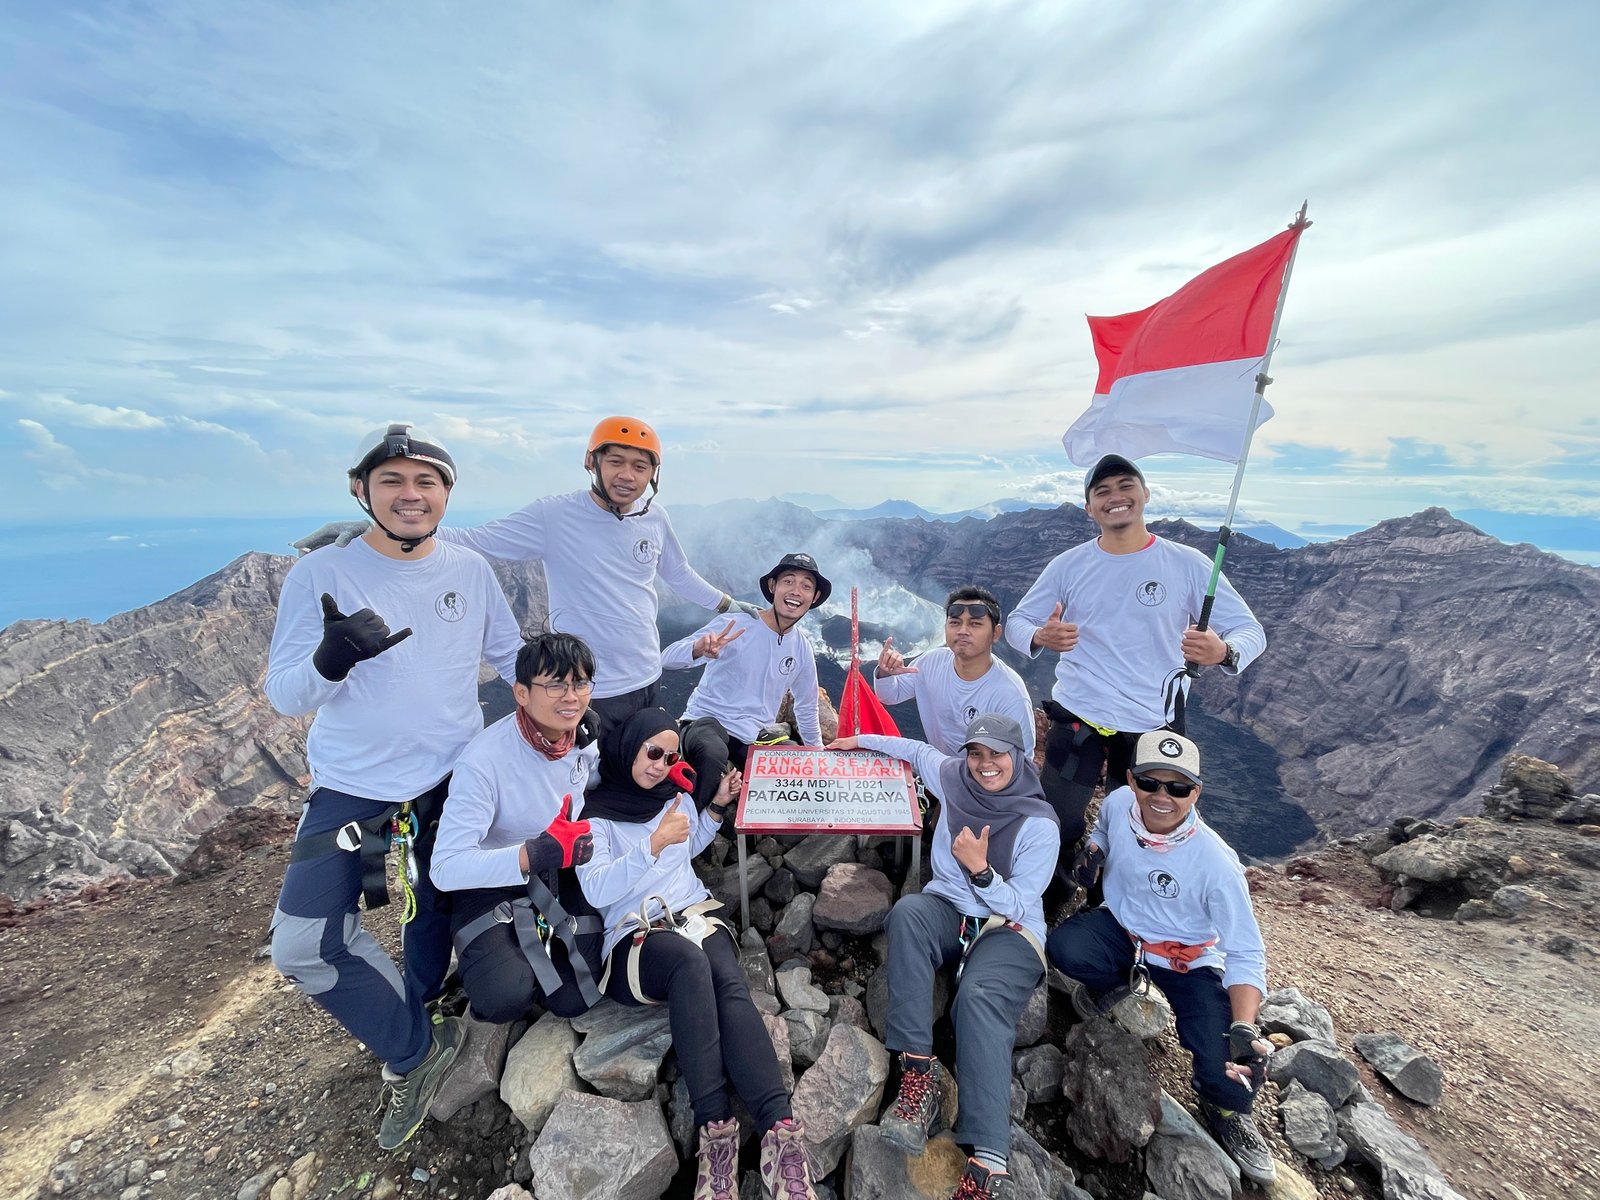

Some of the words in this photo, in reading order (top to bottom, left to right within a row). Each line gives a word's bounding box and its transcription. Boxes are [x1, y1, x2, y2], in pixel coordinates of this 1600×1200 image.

[757, 756, 827, 766] PUNCAK
[836, 757, 903, 768] SEJATI
[755, 765, 814, 776] RAUNG
[818, 766, 903, 777] KALIBARU
[774, 778, 804, 788] 3344
[807, 779, 845, 789] MDPL
[855, 780, 883, 789] 2021
[747, 790, 812, 802] PATAGA
[814, 790, 907, 803] SURABAYA
